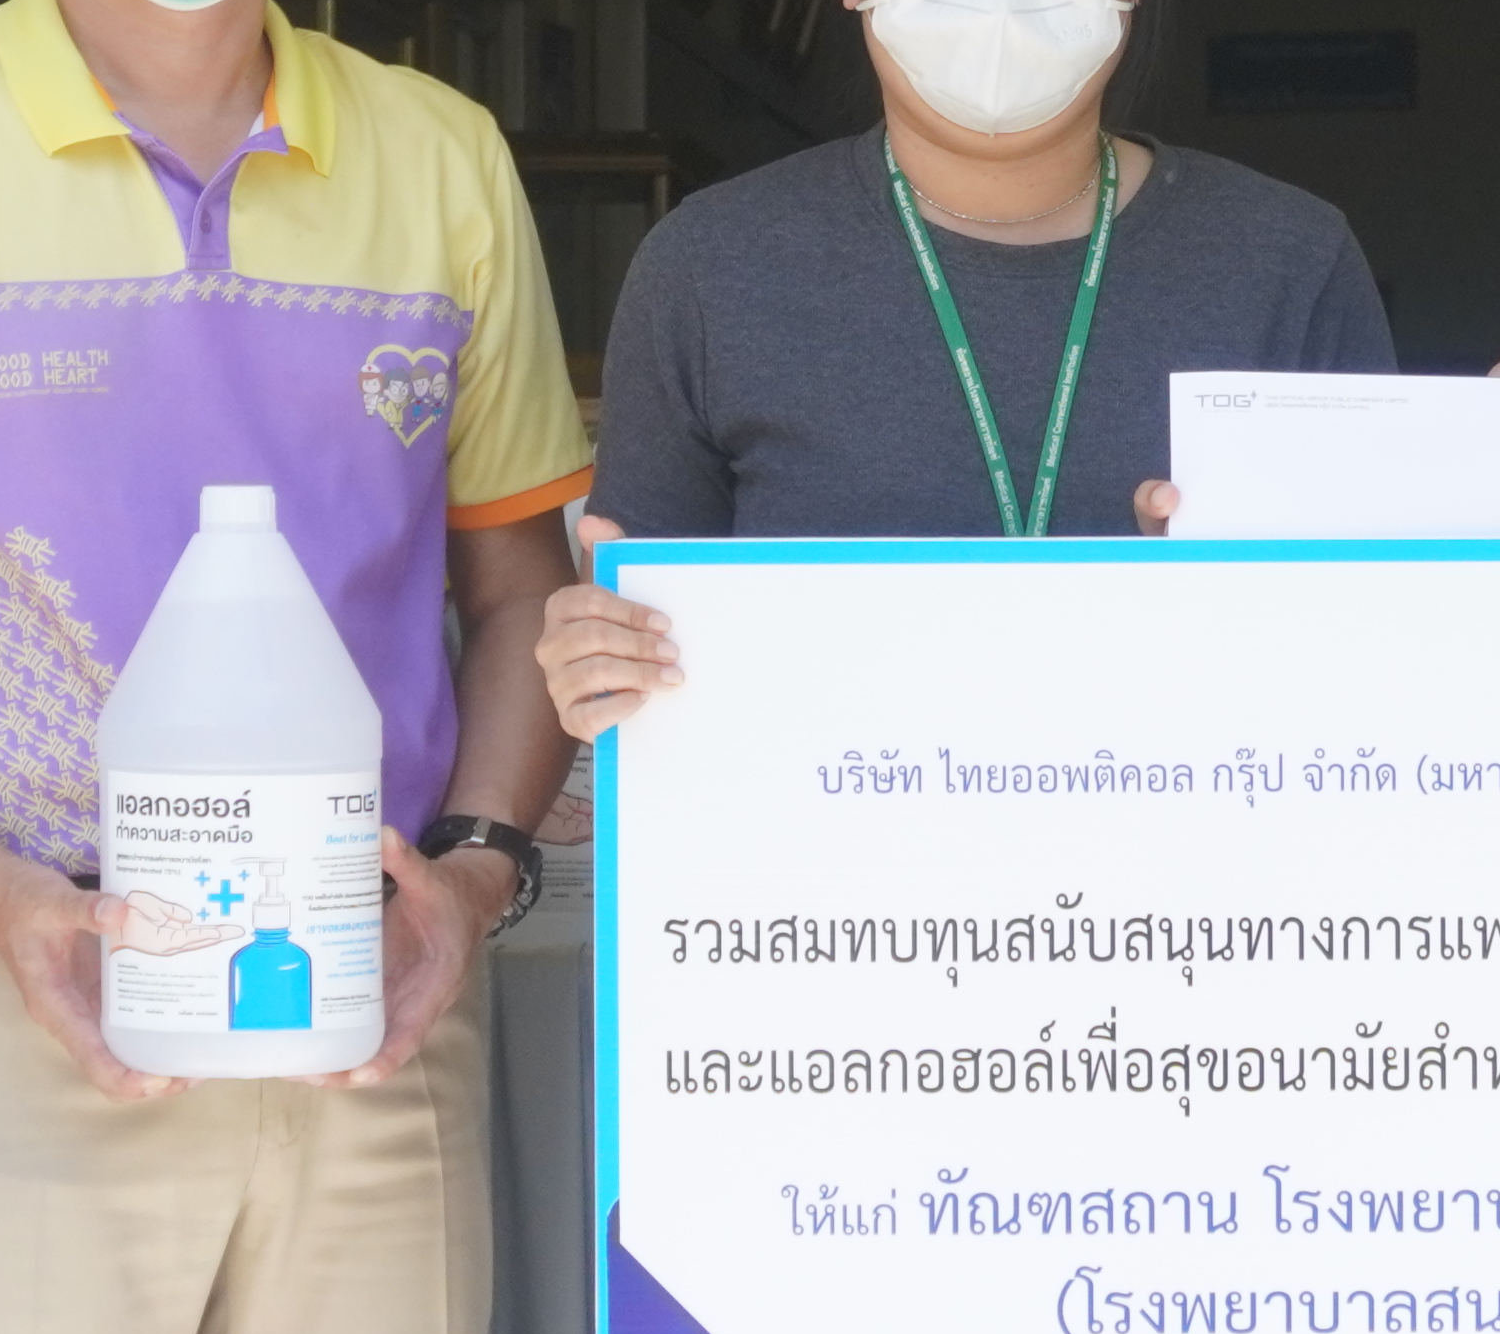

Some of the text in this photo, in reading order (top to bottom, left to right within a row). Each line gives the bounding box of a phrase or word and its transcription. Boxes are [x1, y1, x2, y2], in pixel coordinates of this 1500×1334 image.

[894, 179, 940, 291] Medical Correctional Institution
[42, 349, 109, 368] HEALTH
[43, 367, 98, 386] HEART
[1046, 345, 1080, 467] Medical Correctional Institution
[1194, 394, 1252, 408] TOG
[995, 471, 1011, 504] Medical
[817, 748, 922, 795] บริษัท
[938, 748, 1194, 794] ไทยออพติคอล
[1212, 747, 1285, 809] กรุ๊ป
[1302, 747, 1398, 793] จำกัด
[116, 789, 251, 819] แอลกอฮอล์
[327, 794, 375, 815] TOG
[325, 834, 347, 845] Best
[348, 833, 359, 844] for
[780, 1181, 898, 1236] ให้แก่
[918, 1167, 1240, 1236] ทัณฑสถาน
